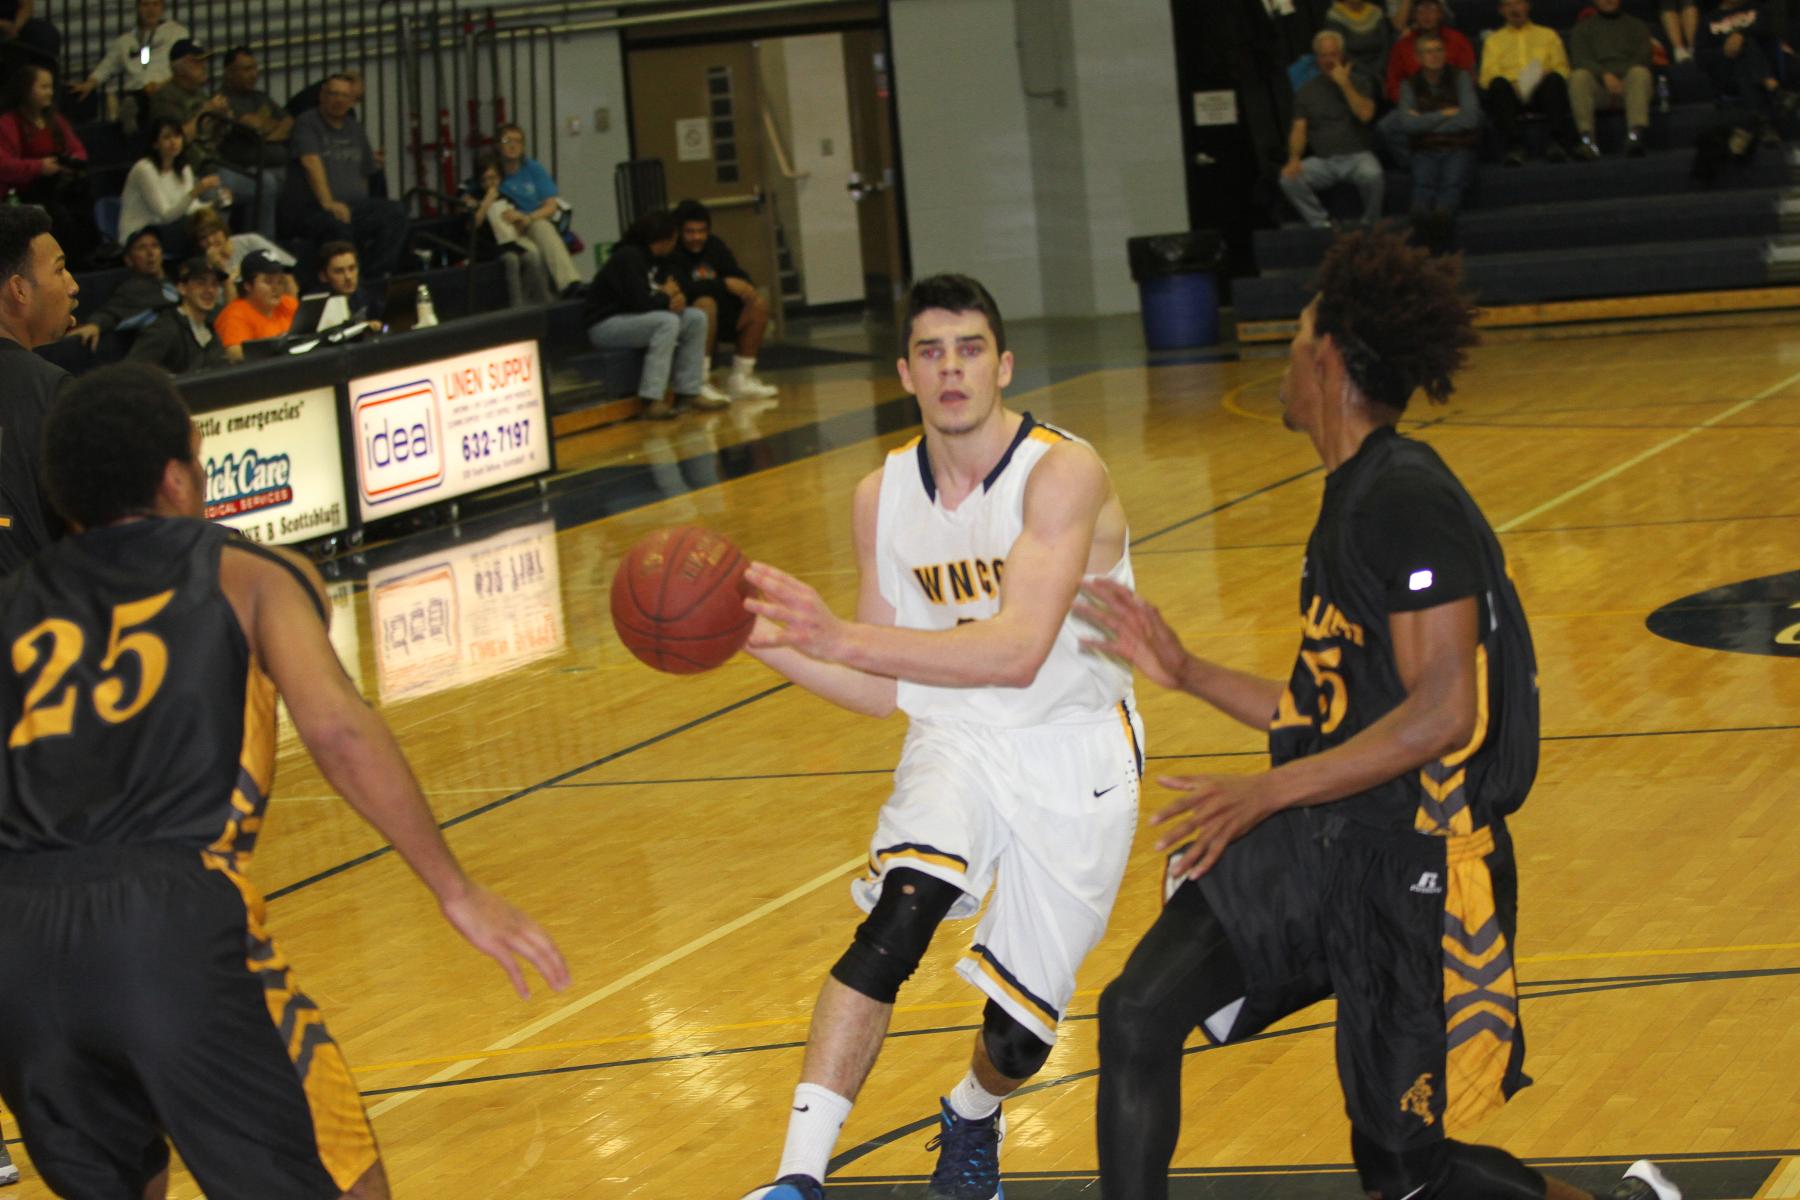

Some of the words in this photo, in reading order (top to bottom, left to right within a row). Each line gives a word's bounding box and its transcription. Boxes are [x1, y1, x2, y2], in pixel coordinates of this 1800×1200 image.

[444, 368, 483, 400] LINEN
[488, 353, 532, 391] SUPPLY
[364, 408, 432, 470] ideal
[463, 418, 530, 461] 632-7197
[240, 488, 289, 510] SERVICES
[280, 502, 341, 535] Scottsbluff
[8, 589, 177, 749] 25
